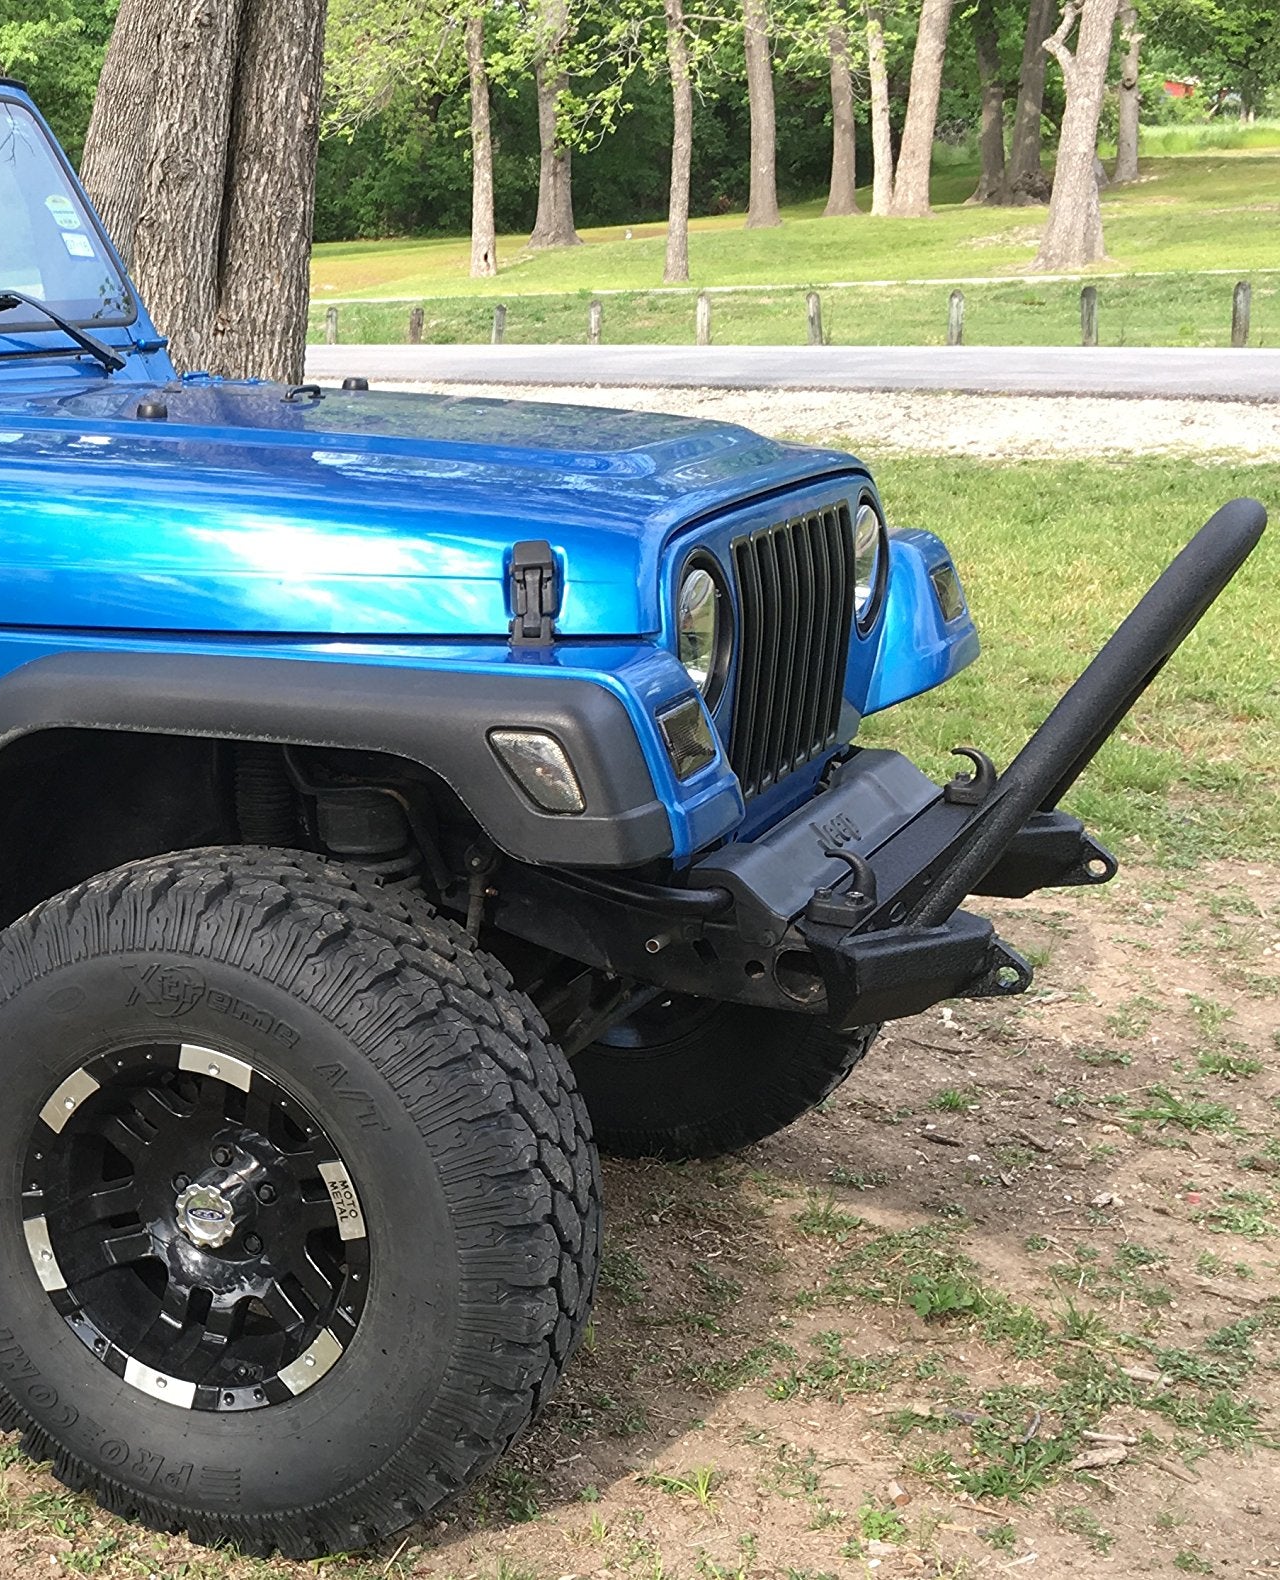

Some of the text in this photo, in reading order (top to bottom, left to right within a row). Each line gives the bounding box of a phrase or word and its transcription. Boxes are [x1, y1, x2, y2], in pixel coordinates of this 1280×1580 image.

[808, 812, 862, 852] Jeep
[120, 961, 392, 1132] Xtreme A/T
[328, 1180, 349, 1222] METAL
[339, 1180, 359, 1219] MOTO
